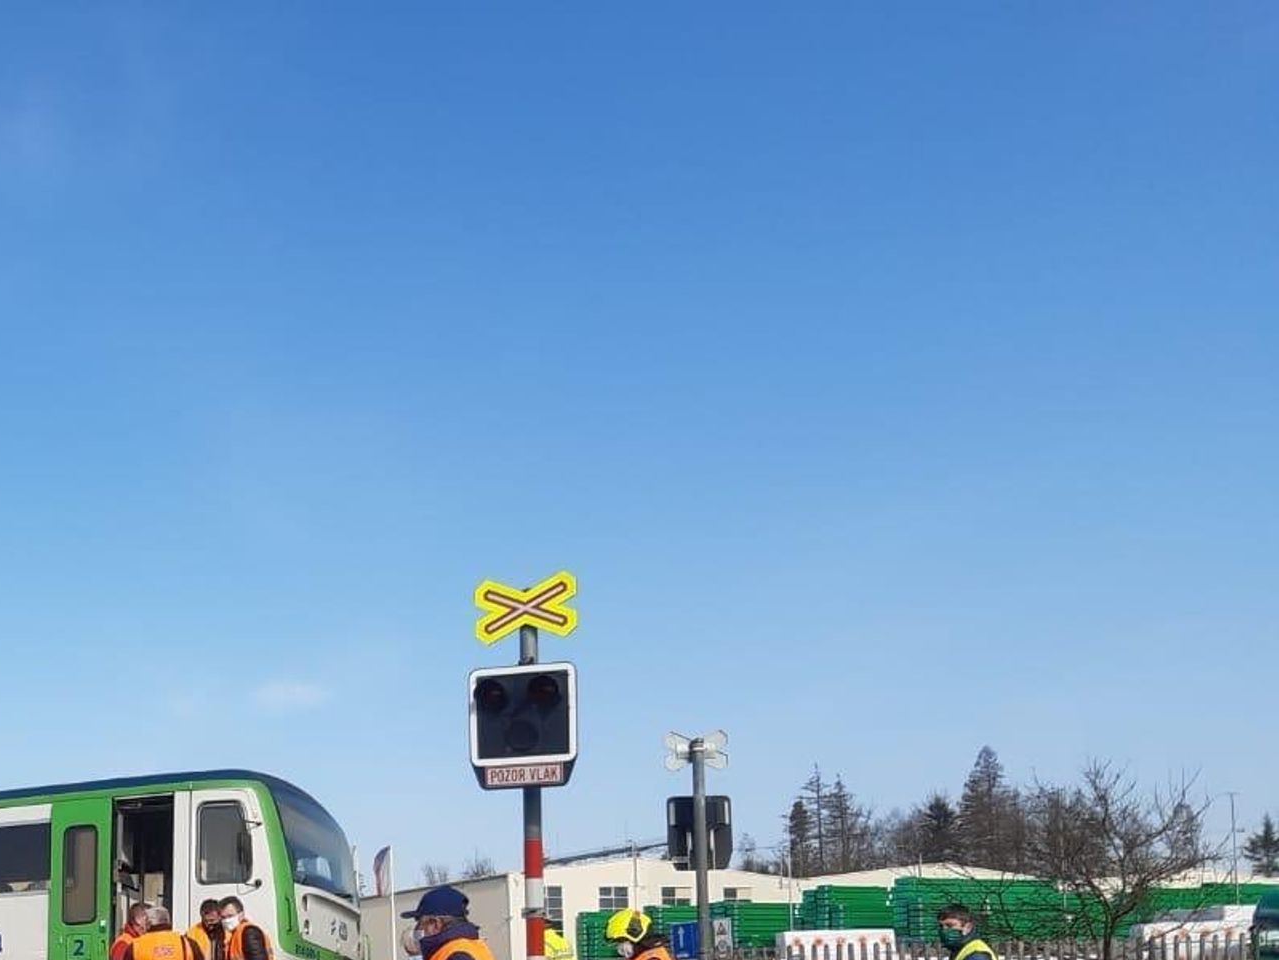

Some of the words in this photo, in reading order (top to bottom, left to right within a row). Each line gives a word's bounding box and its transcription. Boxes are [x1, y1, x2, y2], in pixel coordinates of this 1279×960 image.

[490, 768, 526, 782] POZOR
[529, 766, 558, 781] VLAK
[73, 939, 85, 956] 2
